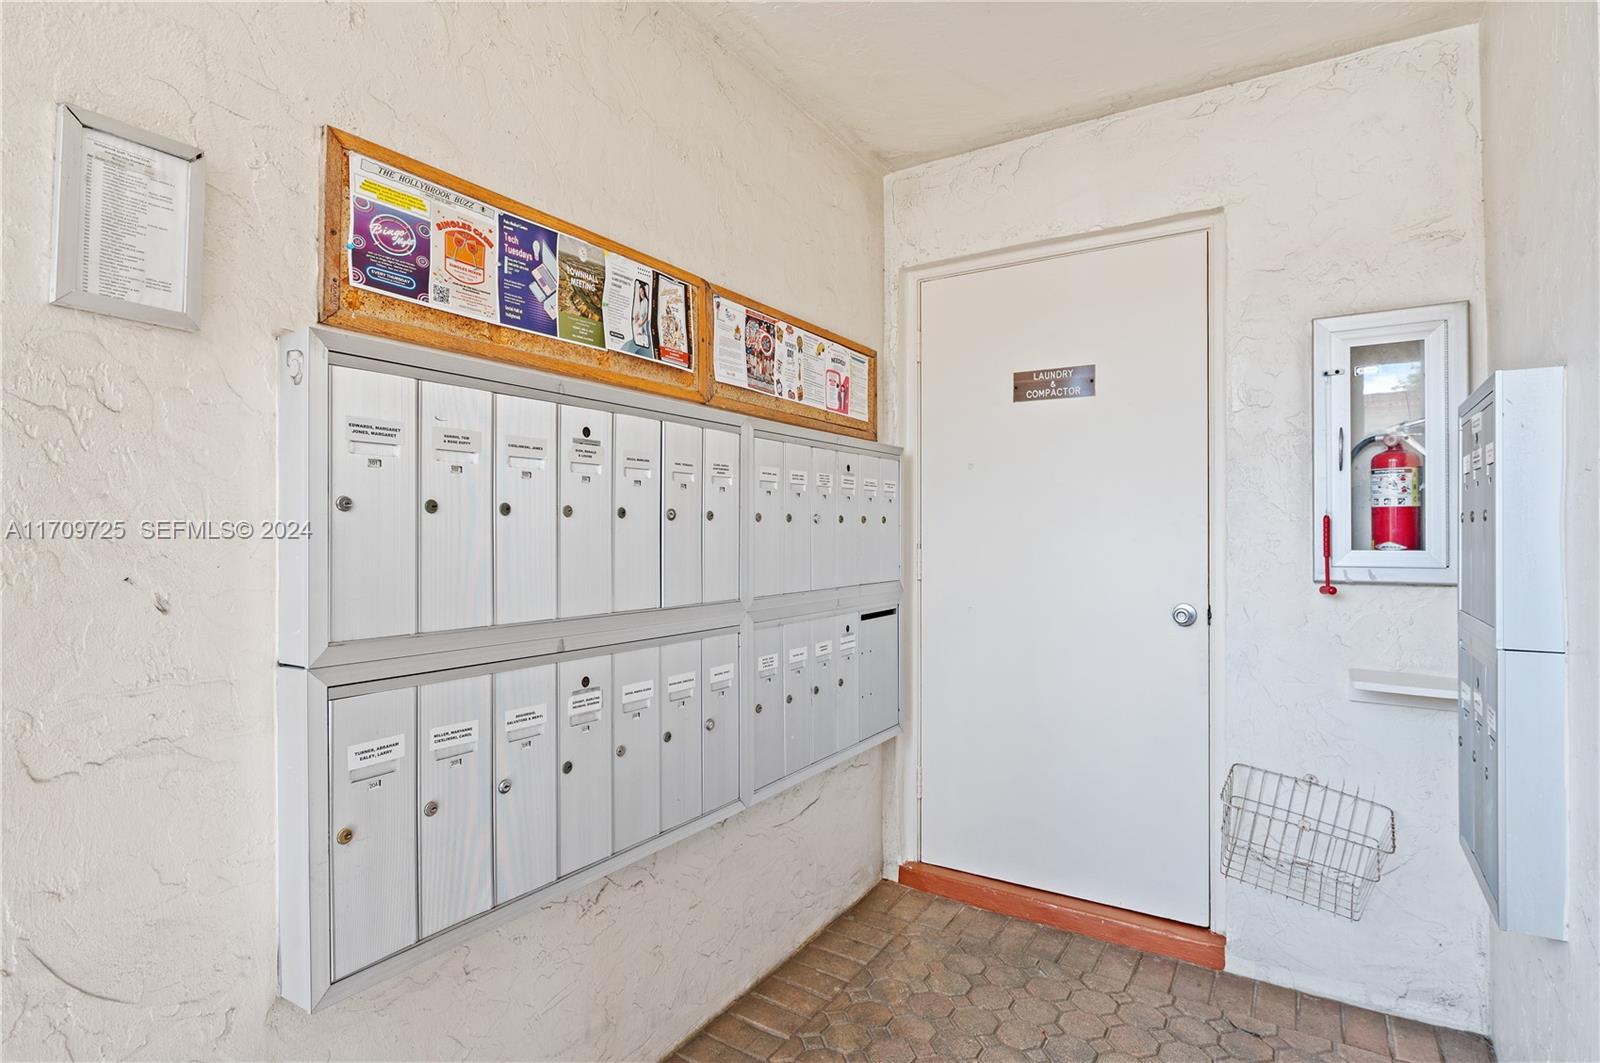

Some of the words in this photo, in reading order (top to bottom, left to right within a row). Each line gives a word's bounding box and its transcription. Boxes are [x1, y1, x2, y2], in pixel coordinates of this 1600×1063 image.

[378, 166, 395, 180] THE
[399, 175, 452, 201] HOLLYBROOK
[454, 193, 475, 210] BUZZ
[369, 223, 408, 241] Bingo
[436, 220, 472, 232] SINGLES
[503, 232, 519, 246] Tech
[503, 243, 533, 261] Tuesdays
[570, 277, 596, 292] MEETING
[1033, 369, 1074, 381] LAUNDRY
[1026, 386, 1081, 399] COMPACTOR
[348, 422, 375, 431] EDWARDS,
[375, 425, 401, 433] MARGARET
[371, 431, 397, 439] MARGARET
[433, 731, 451, 739] MILLER,
[354, 747, 376, 756] TURNER,
[376, 742, 400, 751] ABRAHAM
[377, 749, 393, 757] LARRY
